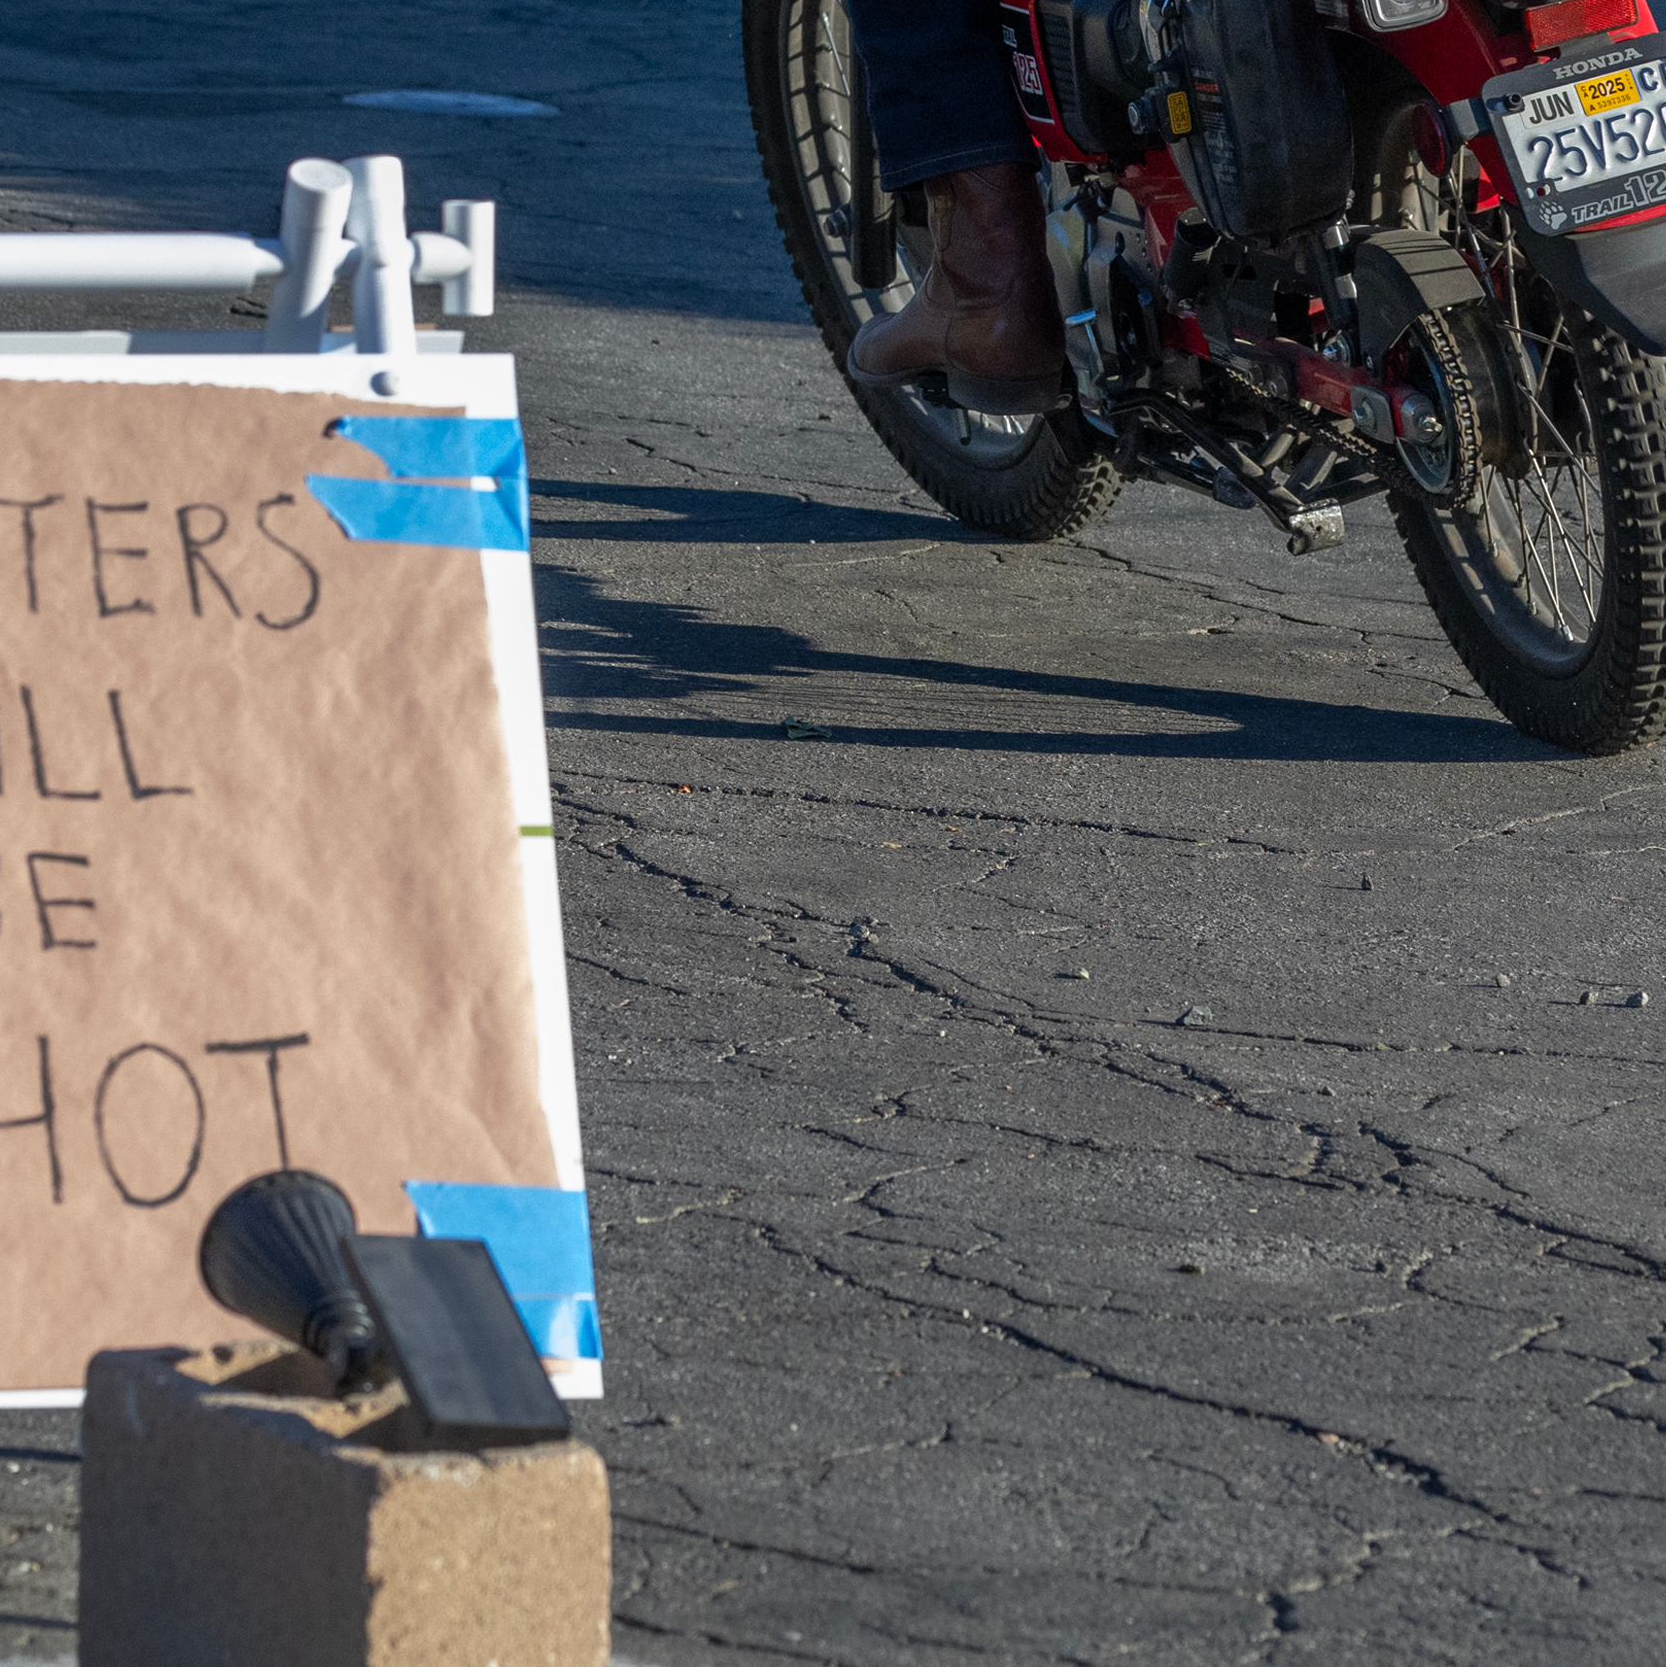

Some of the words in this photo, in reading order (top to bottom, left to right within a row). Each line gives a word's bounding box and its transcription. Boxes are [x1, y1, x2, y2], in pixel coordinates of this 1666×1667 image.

[1012, 50, 1044, 96] 125
[1552, 47, 1643, 80] HONDA
[1588, 77, 1626, 100] 2025
[1528, 91, 1575, 125] JUN
[1571, 194, 1633, 224] TRAIL
